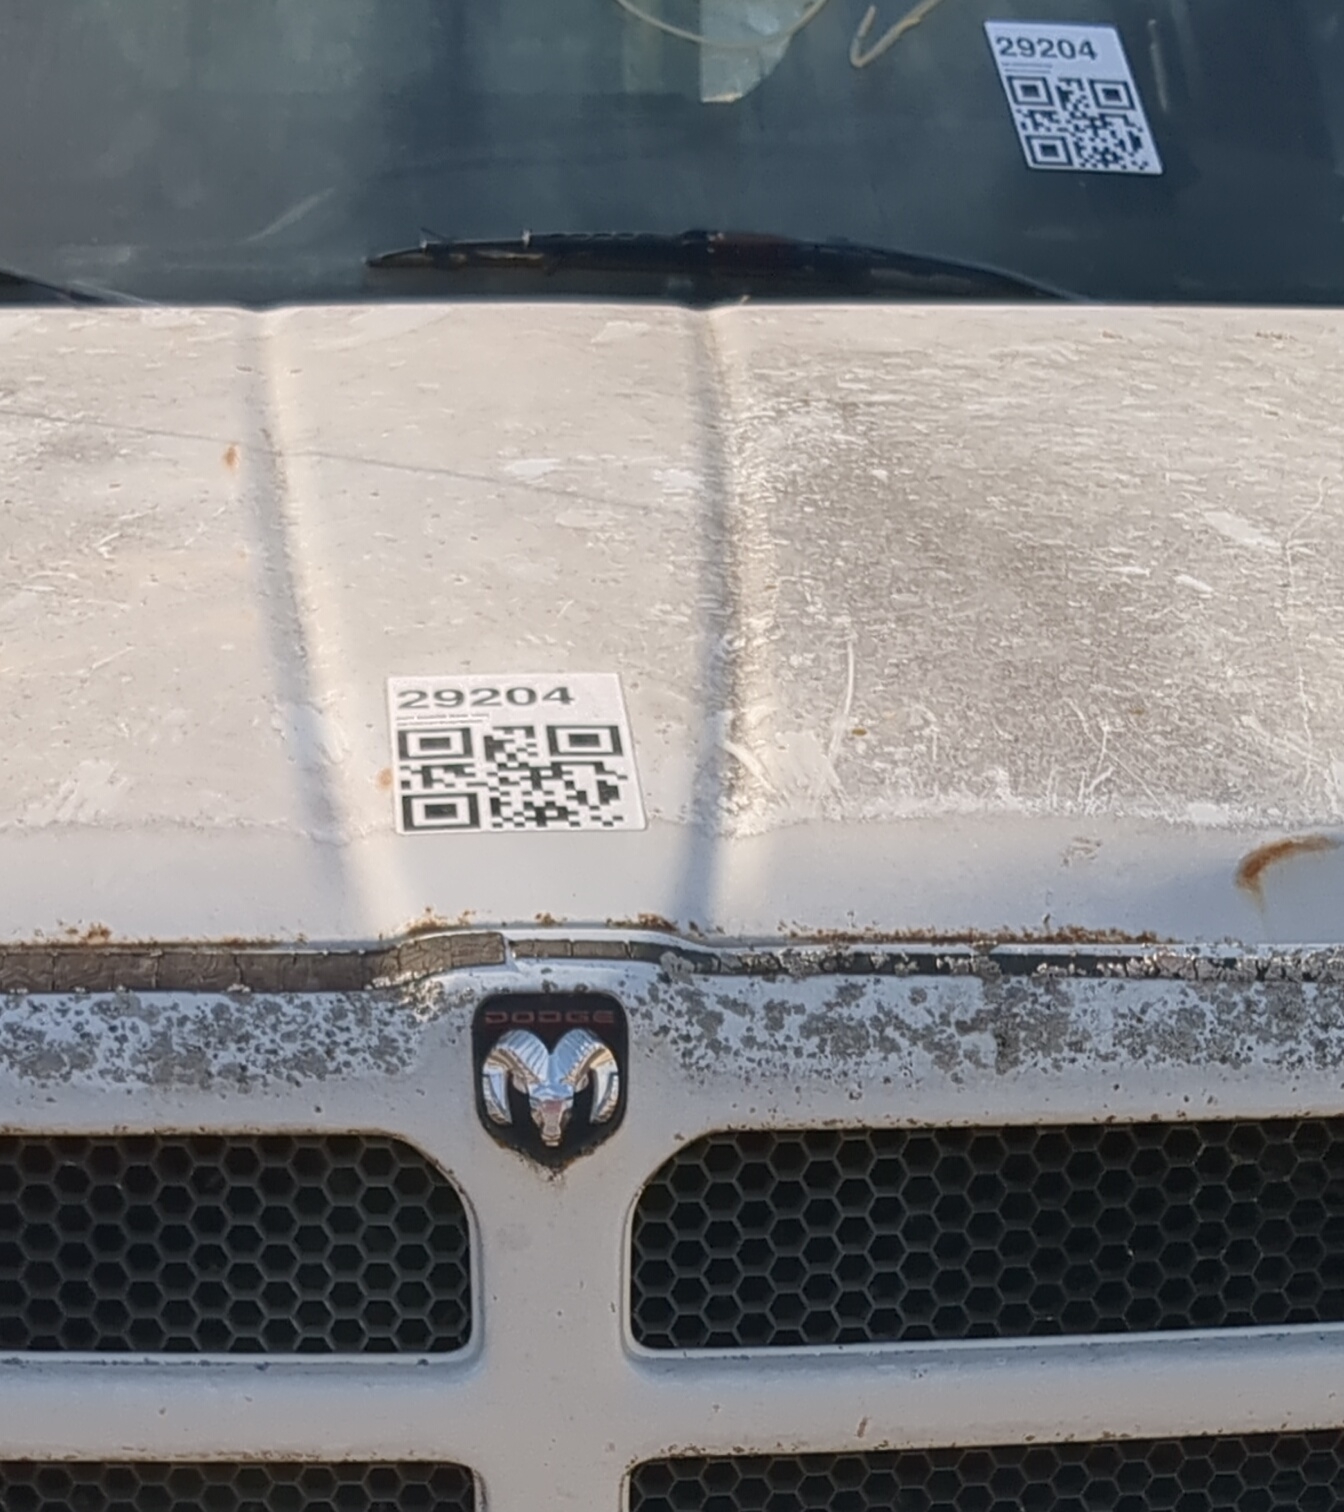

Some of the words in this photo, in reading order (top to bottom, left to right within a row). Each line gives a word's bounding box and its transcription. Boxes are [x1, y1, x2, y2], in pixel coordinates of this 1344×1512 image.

[995, 36, 1098, 61] 29204
[396, 686, 575, 710] 29204
[485, 1010, 614, 1024] DODGE
